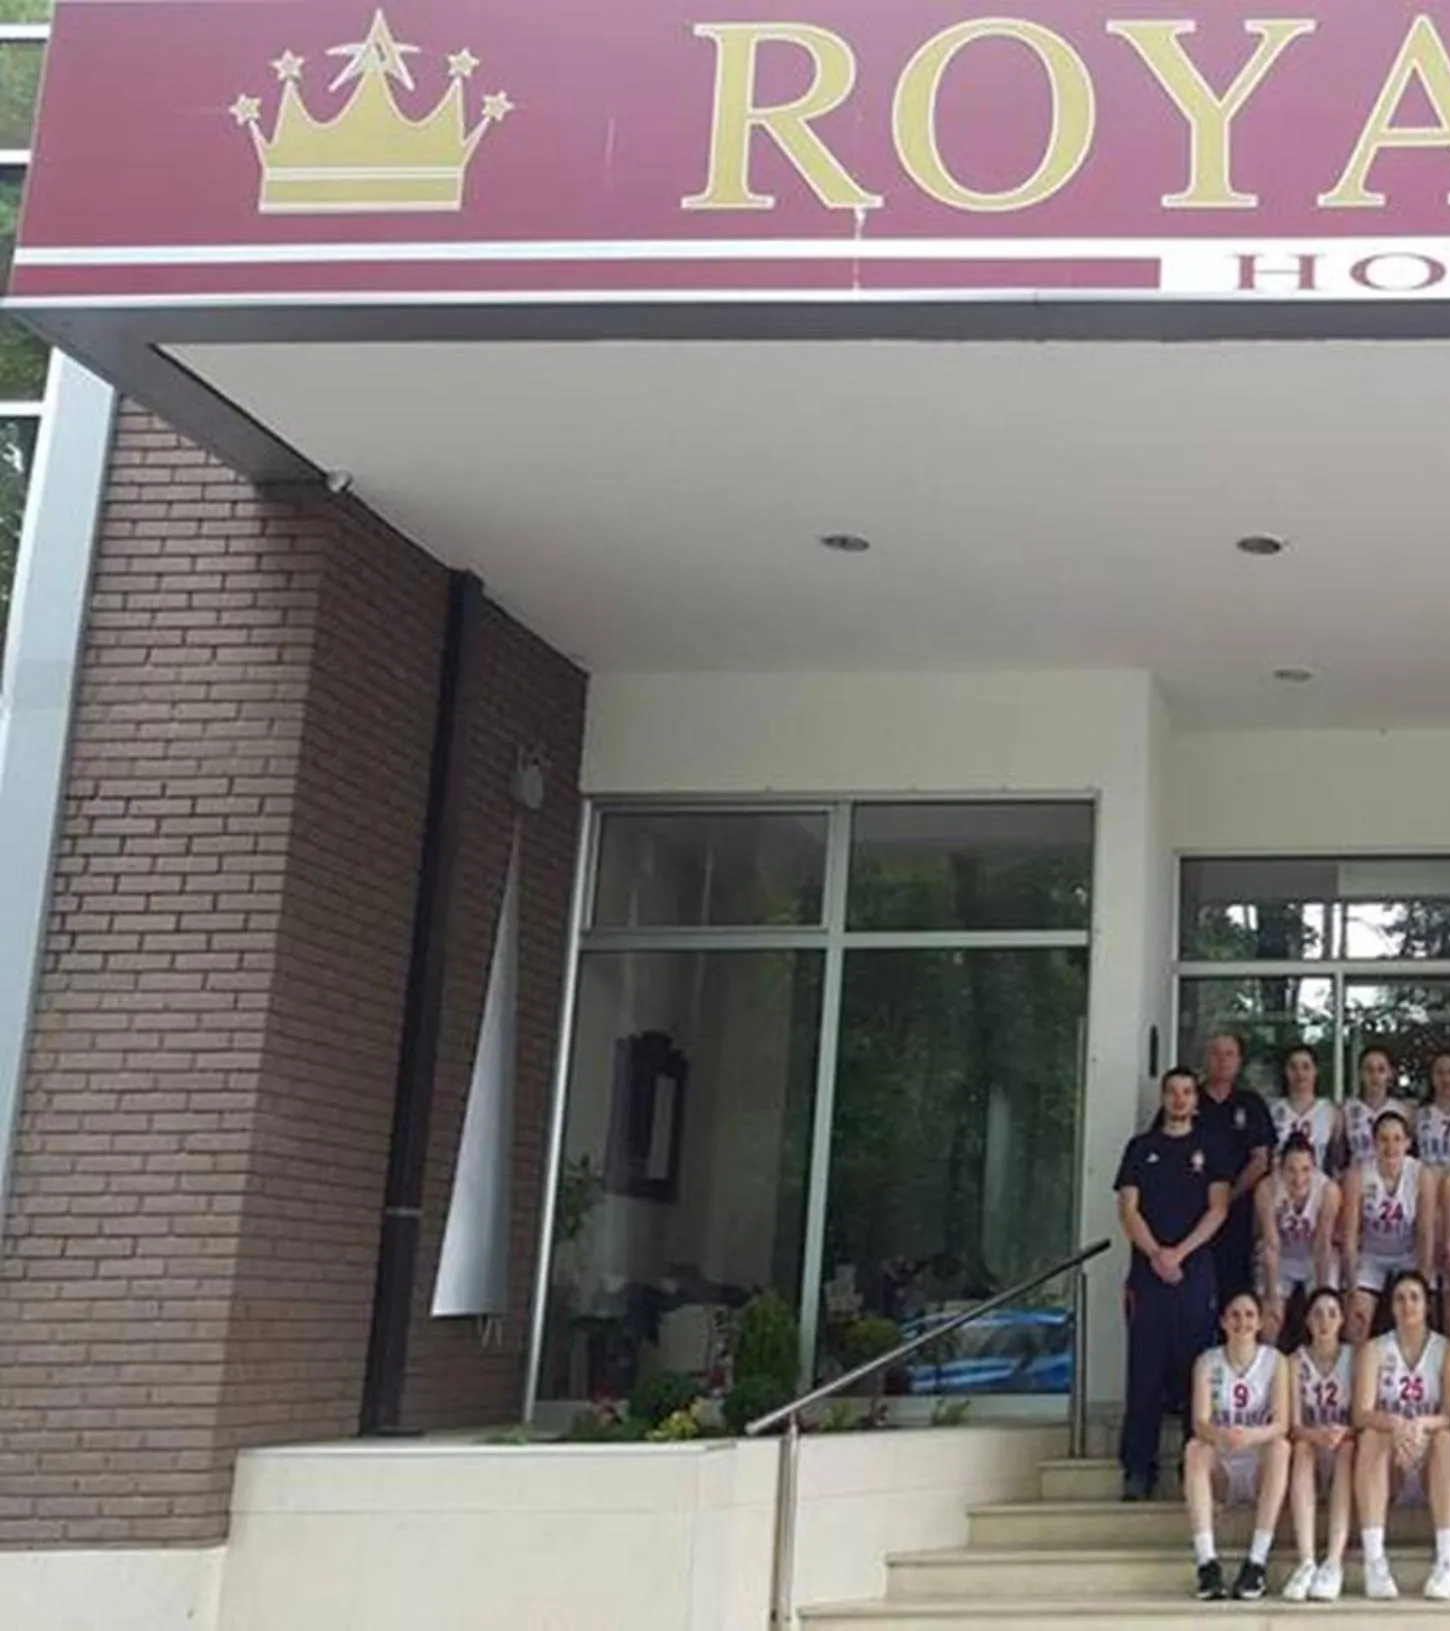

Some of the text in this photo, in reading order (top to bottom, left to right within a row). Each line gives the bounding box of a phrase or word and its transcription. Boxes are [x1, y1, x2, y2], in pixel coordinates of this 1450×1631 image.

[1379, 1200, 1404, 1221] 24
[1233, 1383, 1249, 1408] 9
[1312, 1381, 1338, 1406] 12
